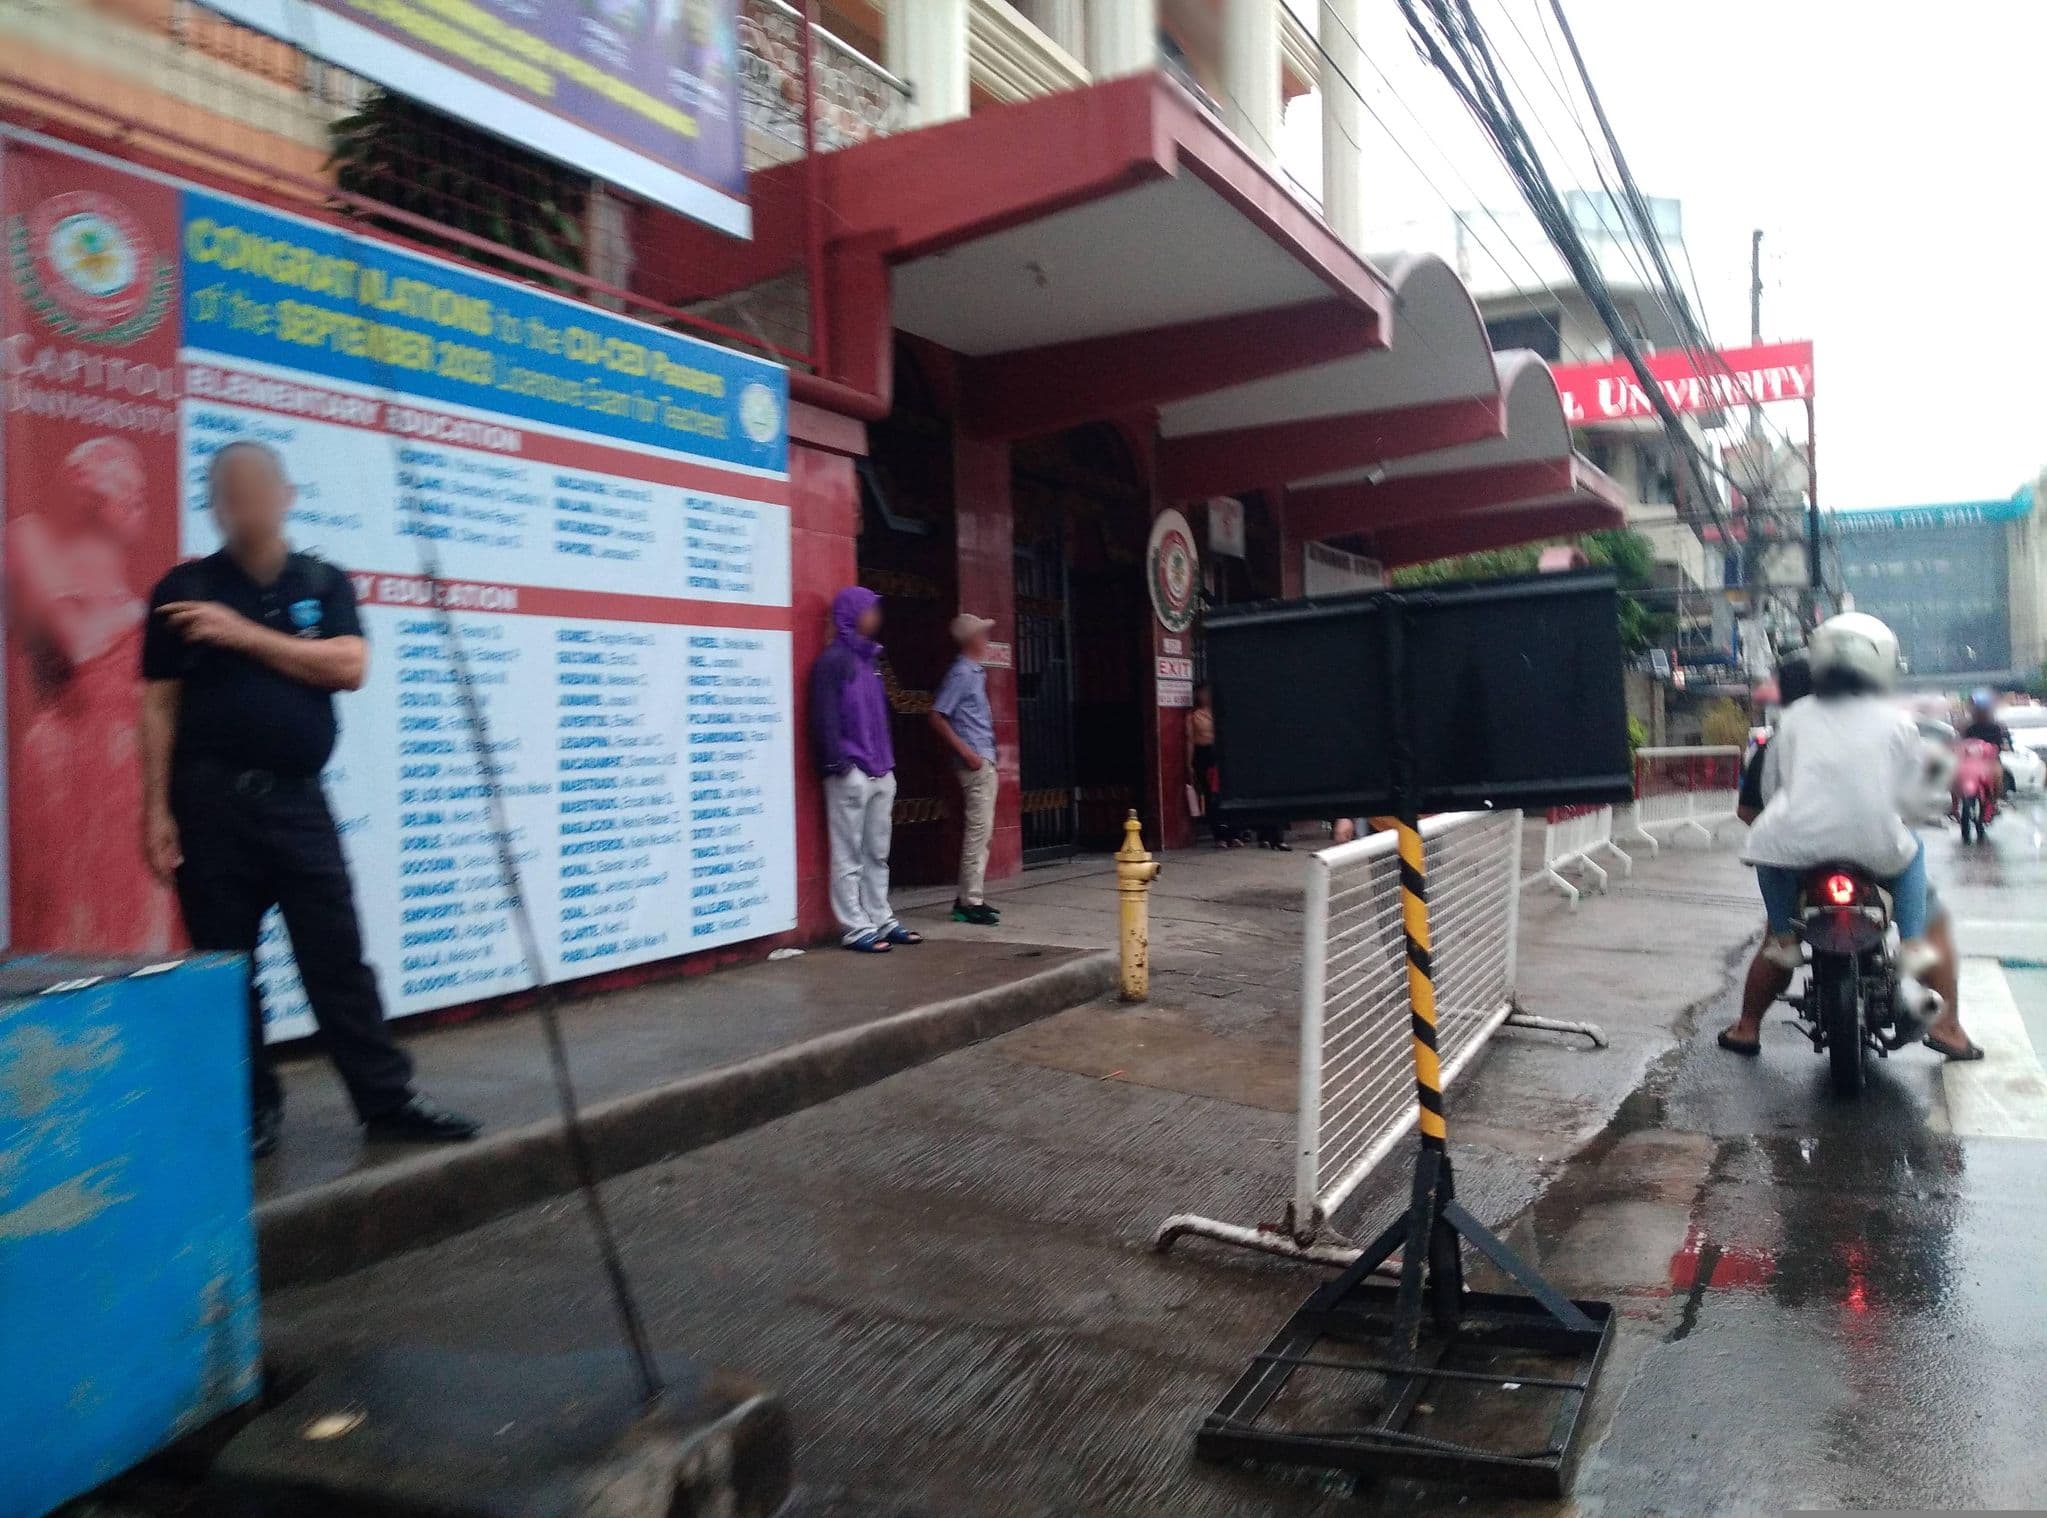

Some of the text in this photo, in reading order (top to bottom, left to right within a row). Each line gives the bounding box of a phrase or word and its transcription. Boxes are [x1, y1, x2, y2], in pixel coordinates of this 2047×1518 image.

[186, 364, 521, 451] ELEMENTARY EDUCATION
[1597, 365, 1811, 416] UNVERSITY
[1159, 660, 1190, 676] EXIT
